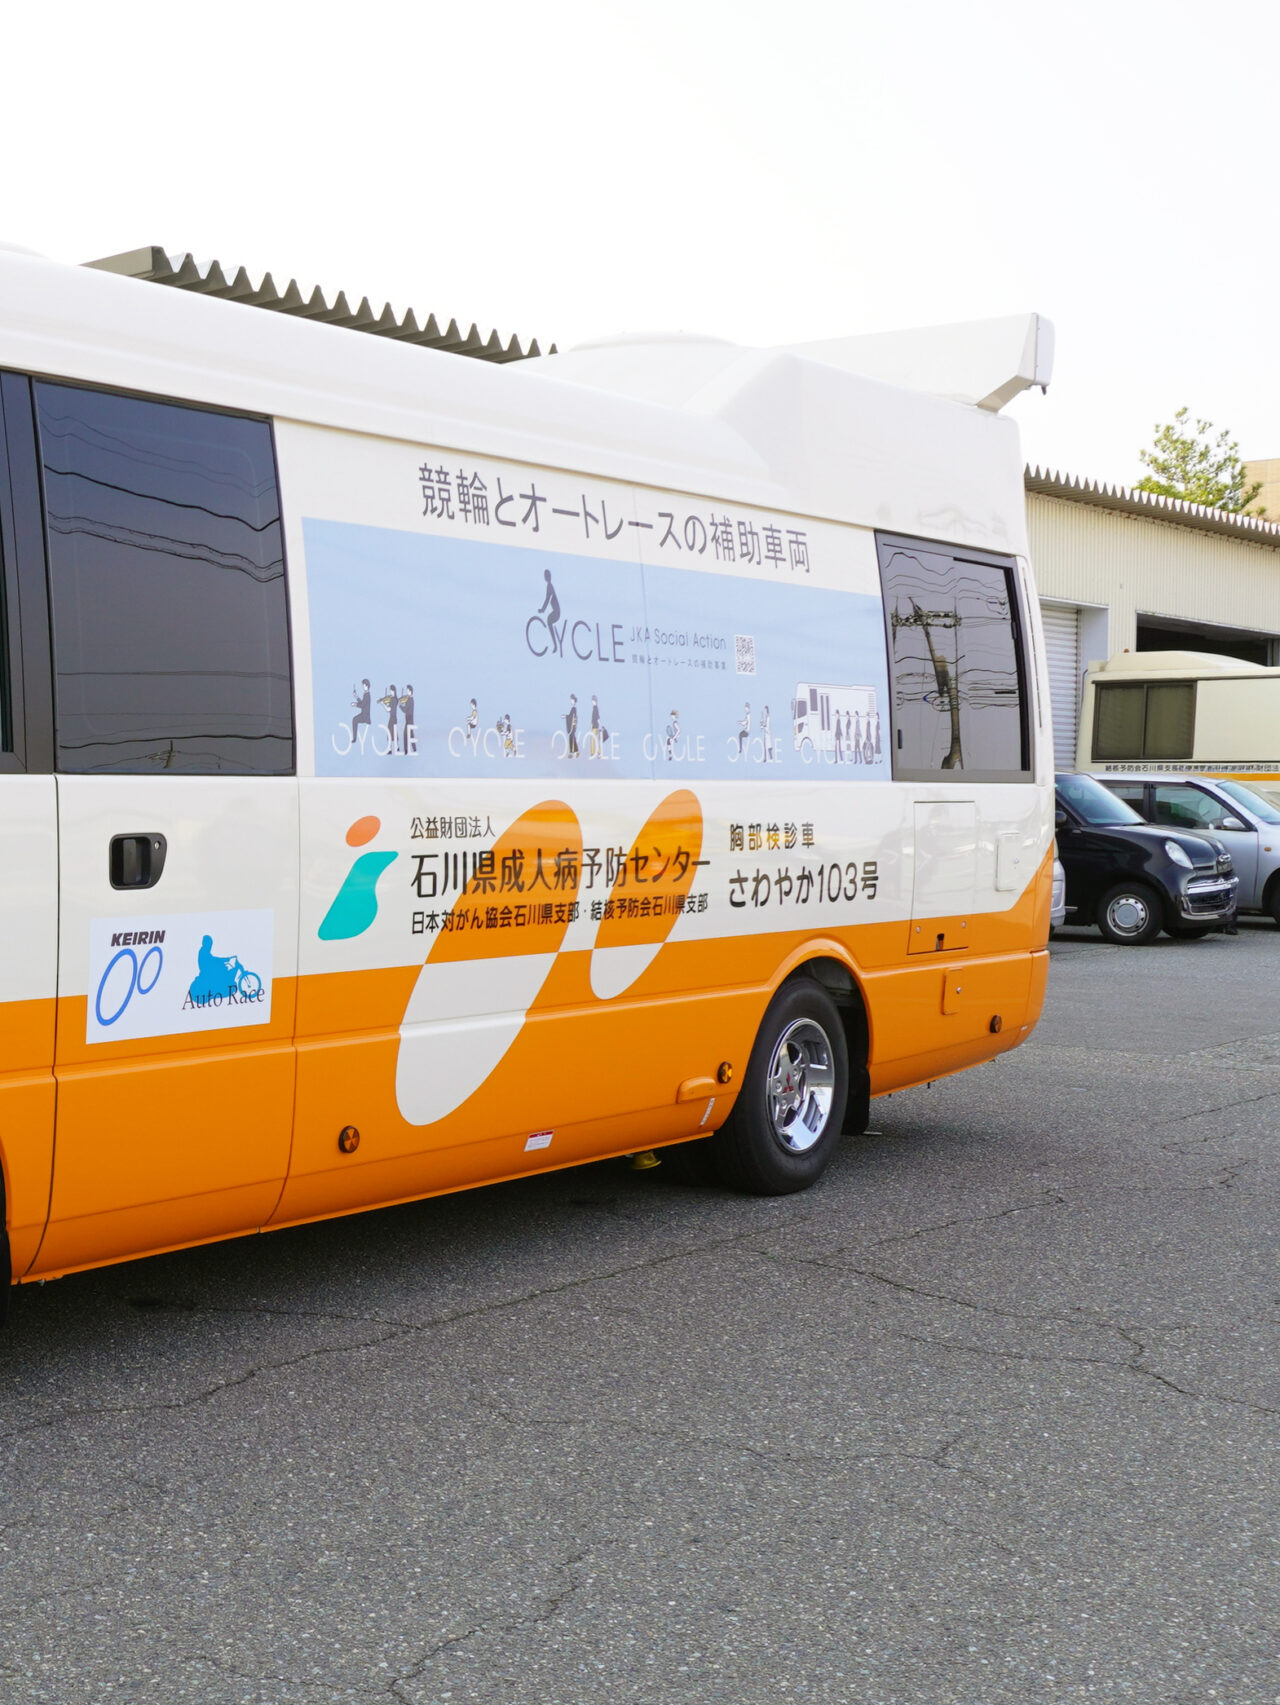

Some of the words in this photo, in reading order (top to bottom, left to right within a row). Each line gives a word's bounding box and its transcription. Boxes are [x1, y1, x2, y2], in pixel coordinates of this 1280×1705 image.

[418, 462, 811, 573] 競輪とオートレースの補助車両
[525, 615, 625, 663] CYCLE
[630, 626, 651, 643] JKA
[654, 628, 689, 647] Social
[693, 632, 727, 650] Action
[410, 816, 496, 840] 公益財団法人
[729, 822, 816, 851] 胸部検診車
[410, 846, 711, 898] 石川県成人病予防センター
[728, 860, 880, 909] さわやか103号
[110, 930, 166, 948] KEIRIN
[181, 989, 223, 1011] Auto
[227, 984, 266, 1007] Race
